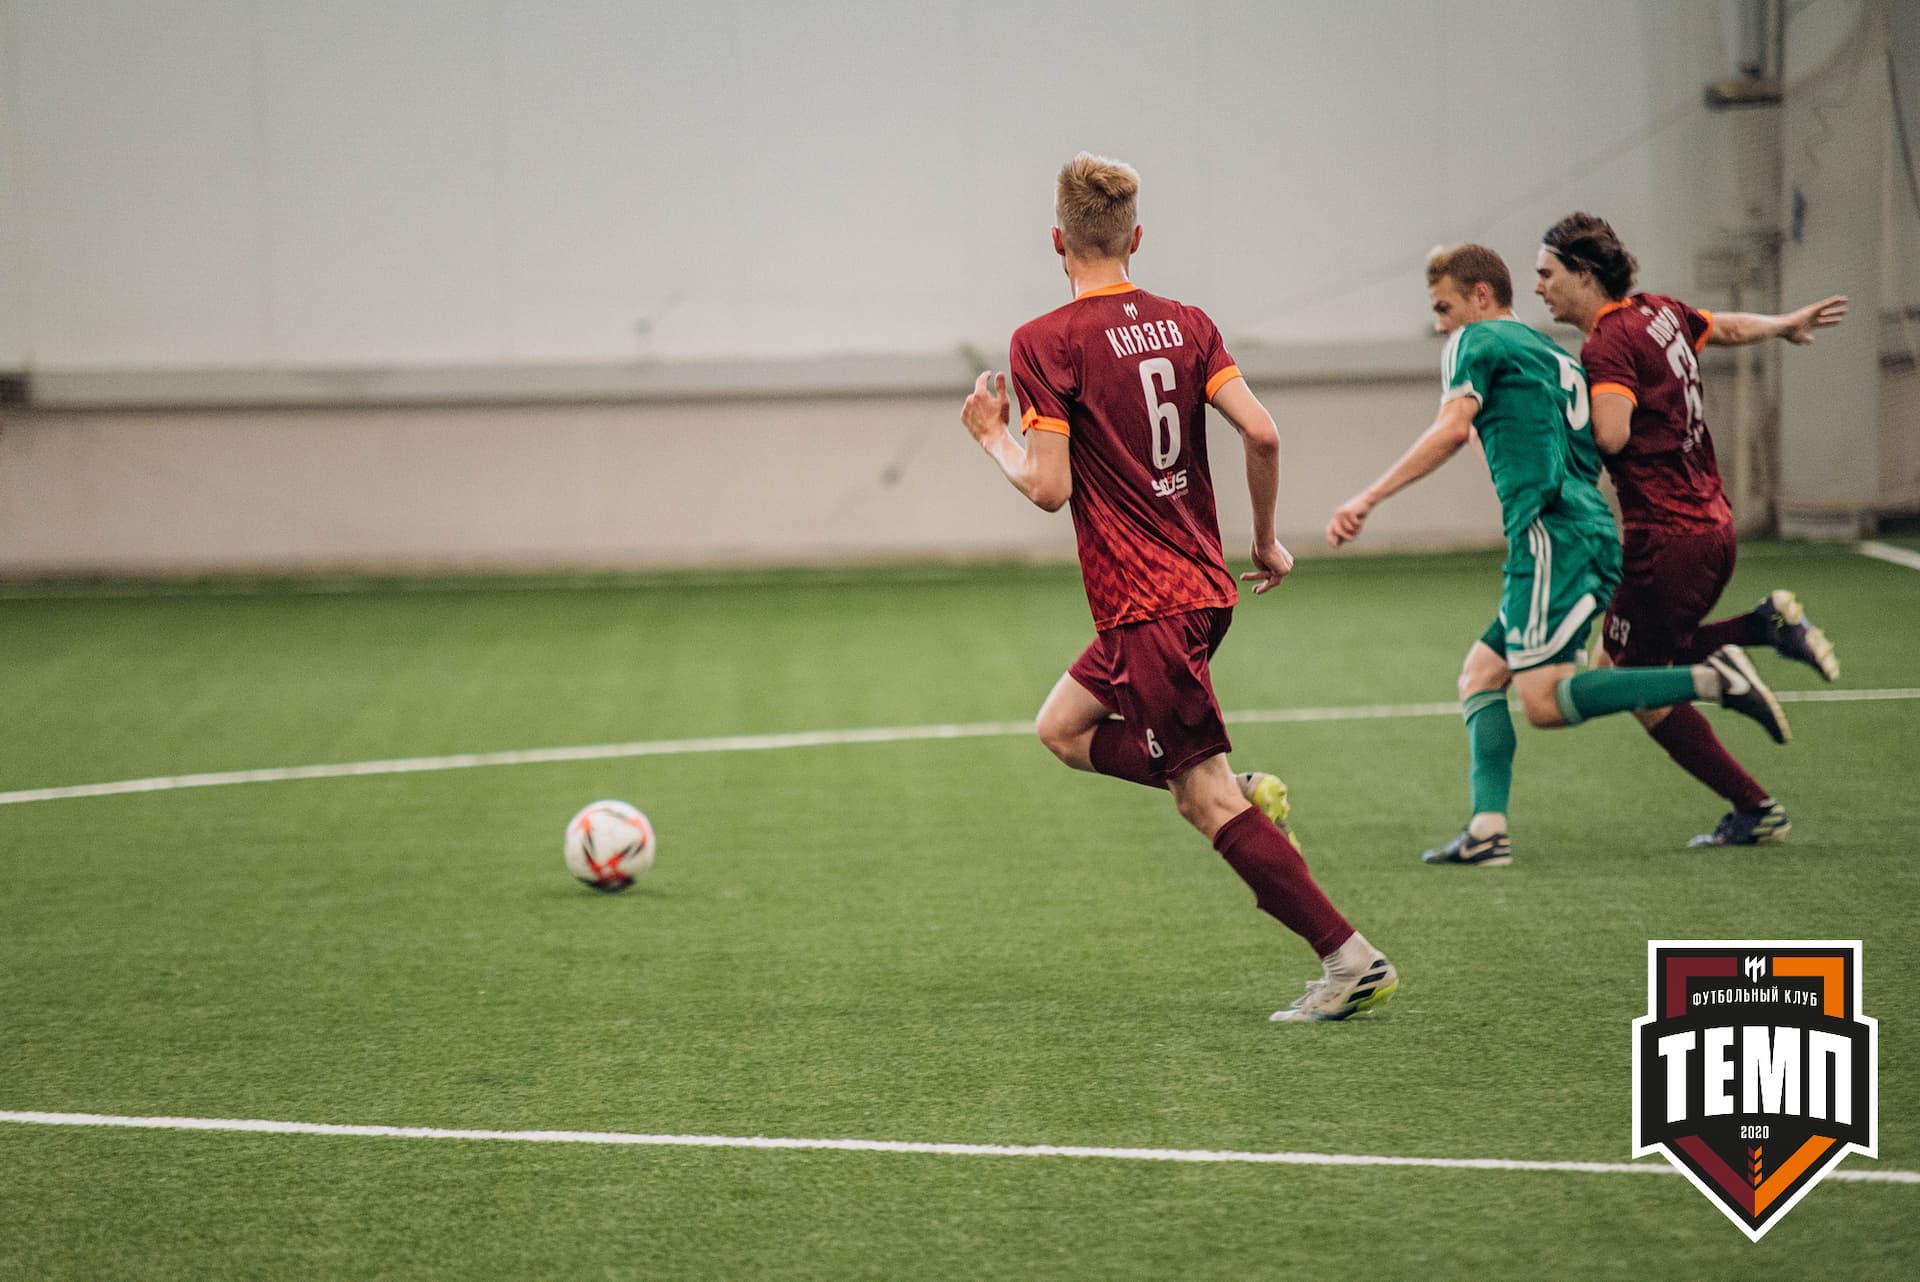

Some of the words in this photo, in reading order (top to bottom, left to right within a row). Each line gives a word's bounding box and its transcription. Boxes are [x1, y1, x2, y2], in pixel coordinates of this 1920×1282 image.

[1105, 319, 1184, 358] КНЯЗЕВ
[1139, 357, 1181, 470] 6
[1551, 350, 1589, 430] 5
[1146, 728, 1164, 758] 6
